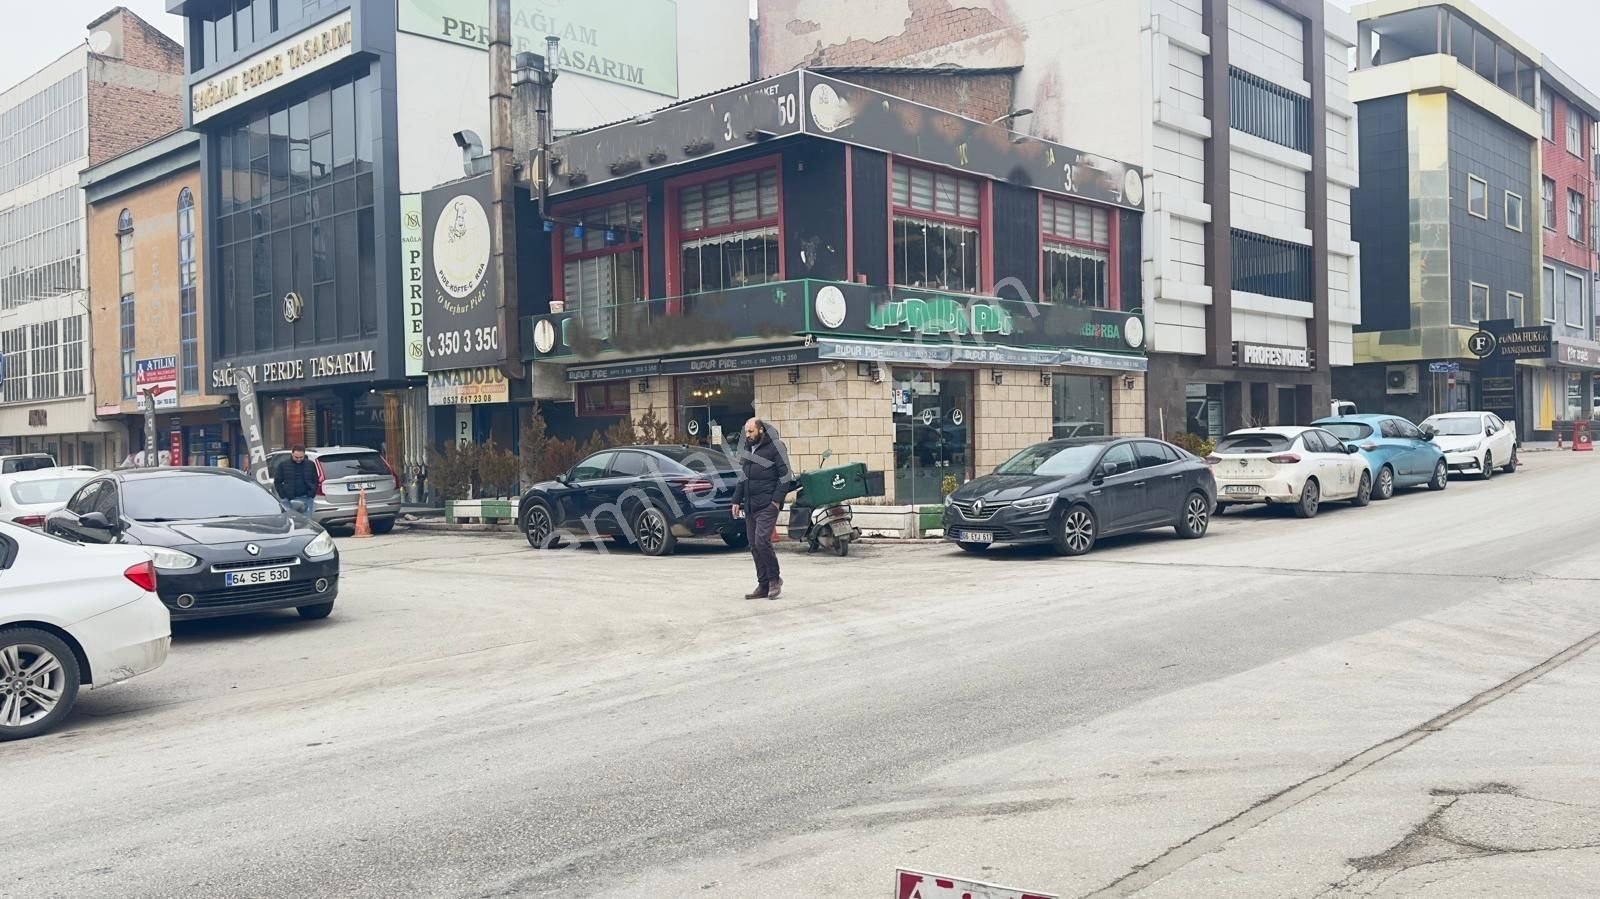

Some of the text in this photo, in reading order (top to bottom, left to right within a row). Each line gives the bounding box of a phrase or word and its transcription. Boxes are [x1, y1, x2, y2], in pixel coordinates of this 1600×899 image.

[513, 8, 600, 48] AĞLAM
[242, 54, 284, 92] PERDE
[287, 21, 352, 70] TASARIM
[410, 250, 423, 334] PERDE
[438, 331, 460, 356] 350
[463, 329, 472, 353] 3
[475, 325, 498, 351] 350
[1476, 337, 1486, 351] F
[146, 357, 175, 370] ATILIM
[263, 359, 304, 382] PERDE
[310, 350, 375, 378] TASARIM
[1244, 345, 1310, 368] PROFESYONEL
[443, 396, 458, 405] 0537
[460, 395, 472, 404] 617
[474, 395, 482, 403] 23
[232, 569, 289, 584] 64 SE 530
